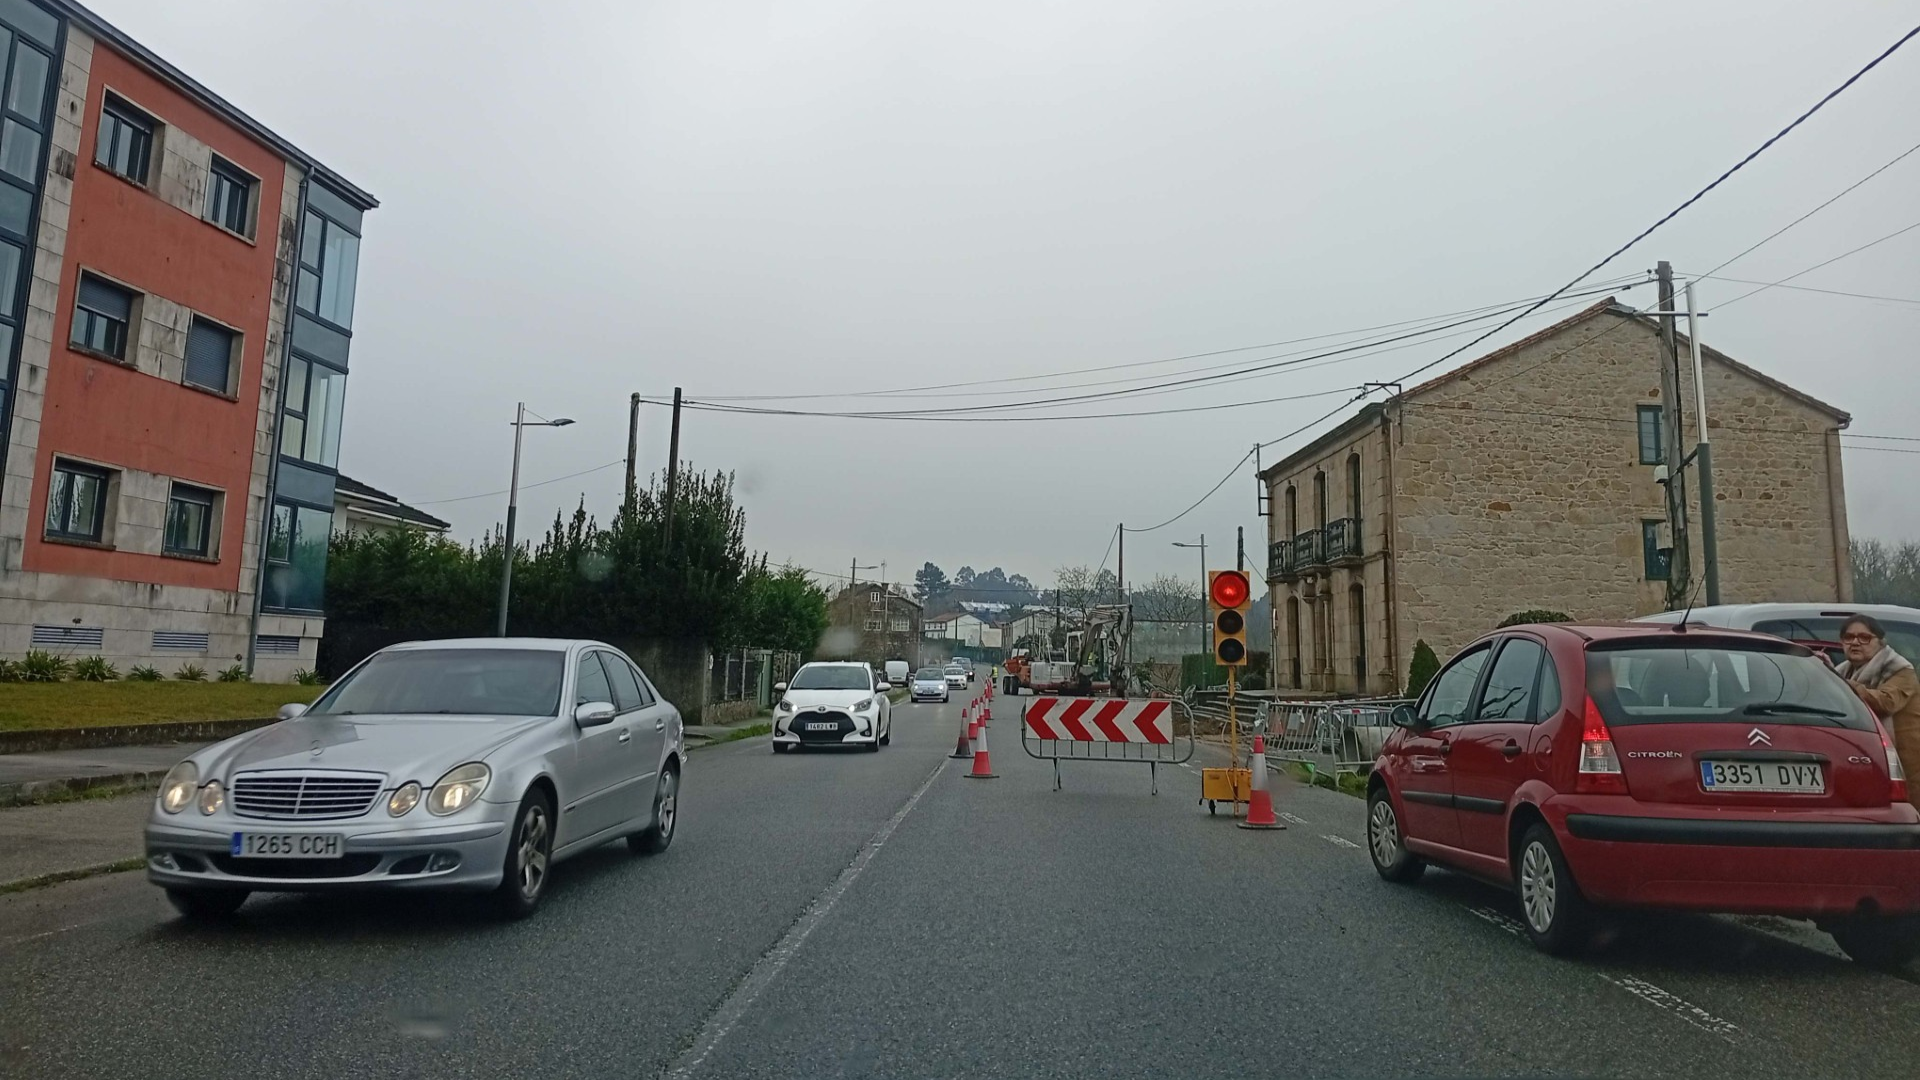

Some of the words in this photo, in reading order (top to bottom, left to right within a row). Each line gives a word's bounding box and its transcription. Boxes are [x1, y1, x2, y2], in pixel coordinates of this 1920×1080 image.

[1627, 750, 1683, 758] CITROËN
[1847, 755, 1872, 764] C3
[1713, 764, 1764, 785] 3351
[1777, 765, 1821, 787] DVX
[247, 835, 293, 854] 1265
[300, 835, 339, 854] CCH
